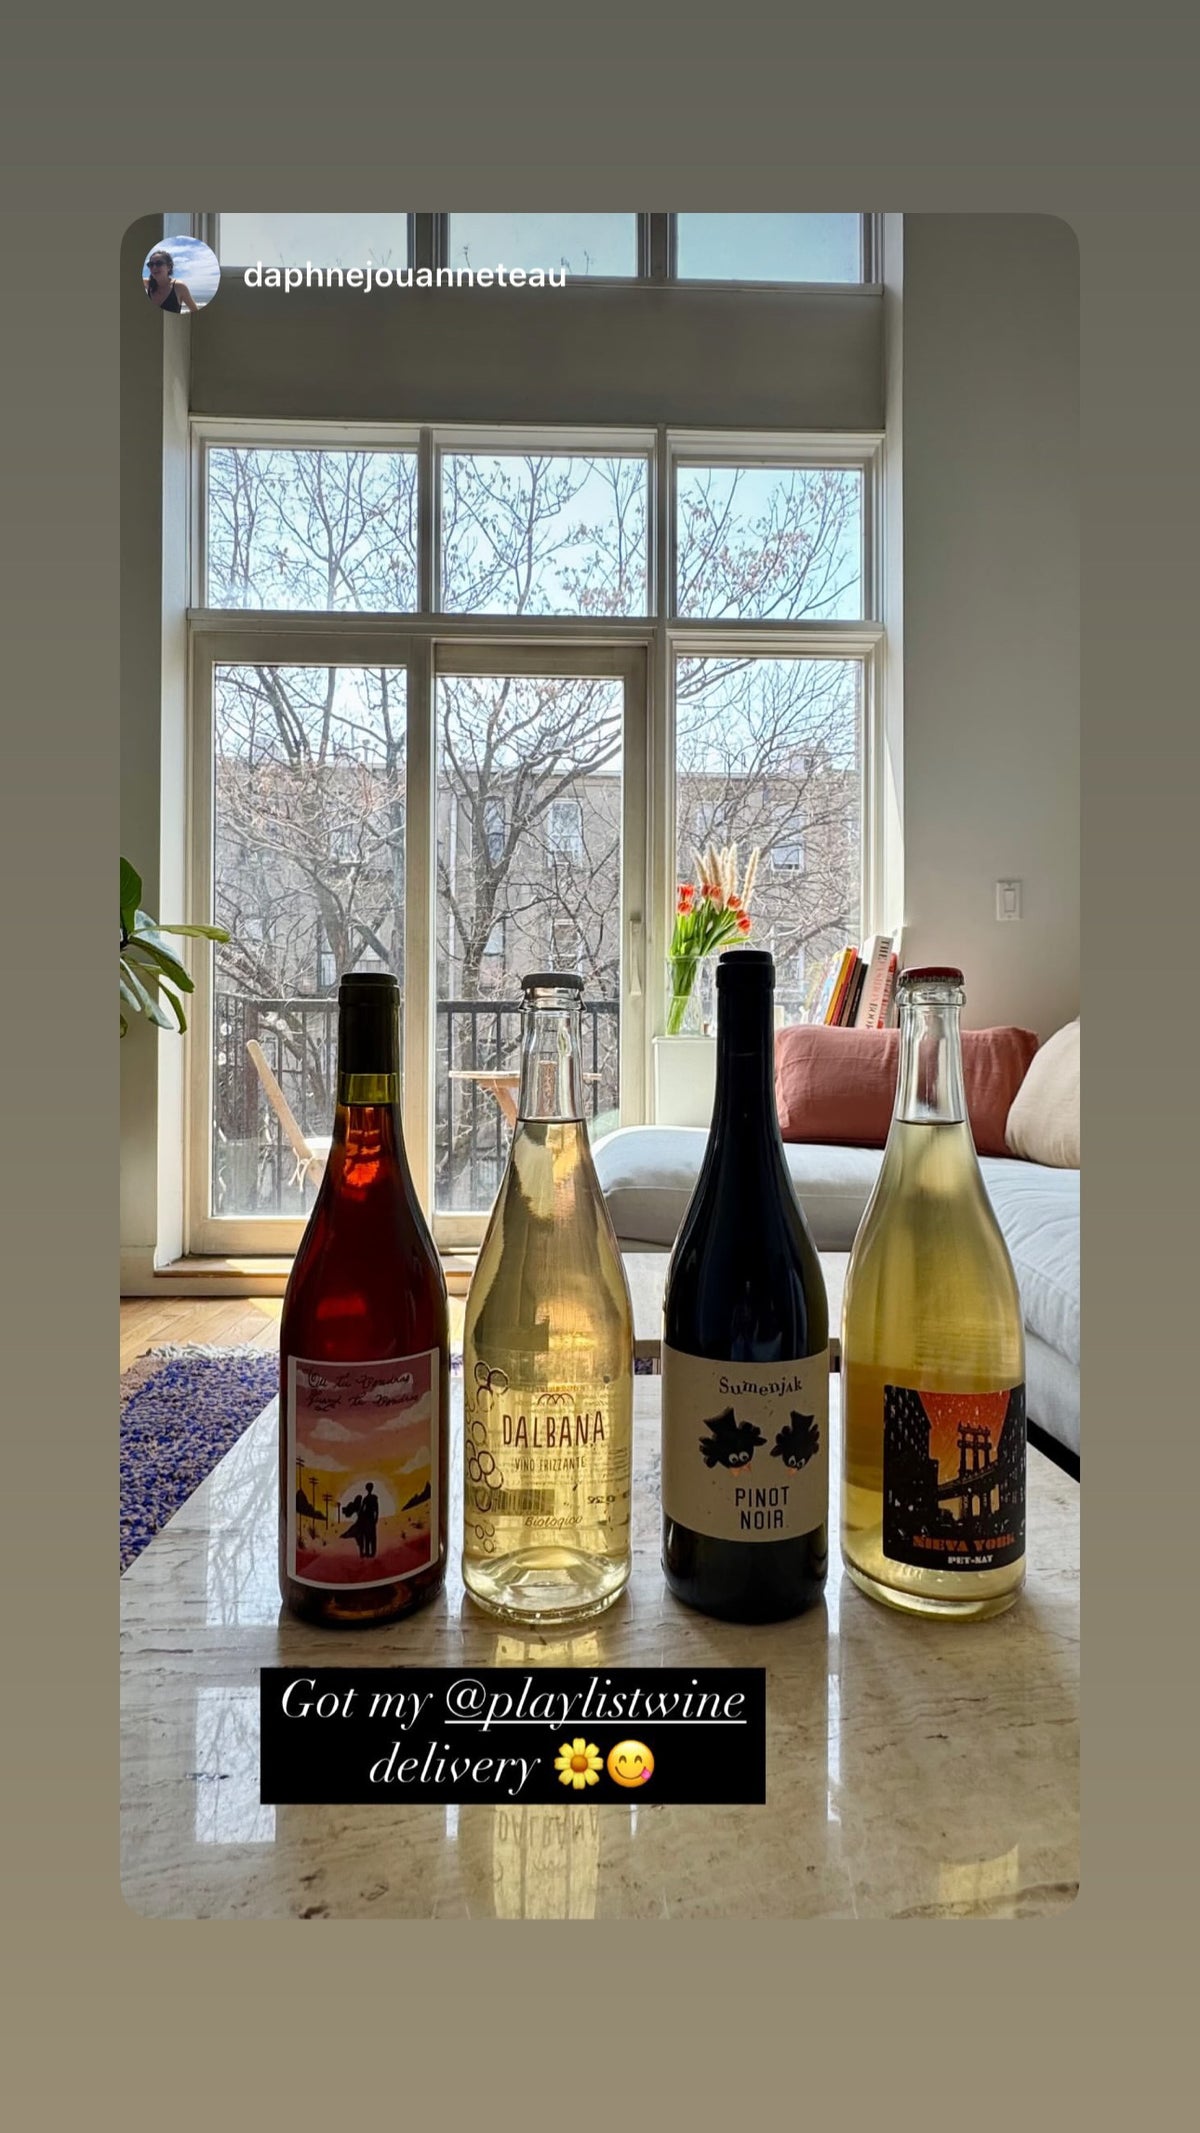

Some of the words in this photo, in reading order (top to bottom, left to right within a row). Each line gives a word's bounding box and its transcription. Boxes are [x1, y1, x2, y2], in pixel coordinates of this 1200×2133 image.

[503, 1411, 605, 1448] DALBANA
[514, 1457, 535, 1472] VINO
[539, 1456, 586, 1472] FRIZZANTE
[735, 1486, 790, 1507] PINOT
[524, 1515, 583, 1531] Biologico
[740, 1510, 784, 1530] NOIR
[972, 1531, 1016, 1551] YORK
[946, 1553, 994, 1566] PET-NAT
